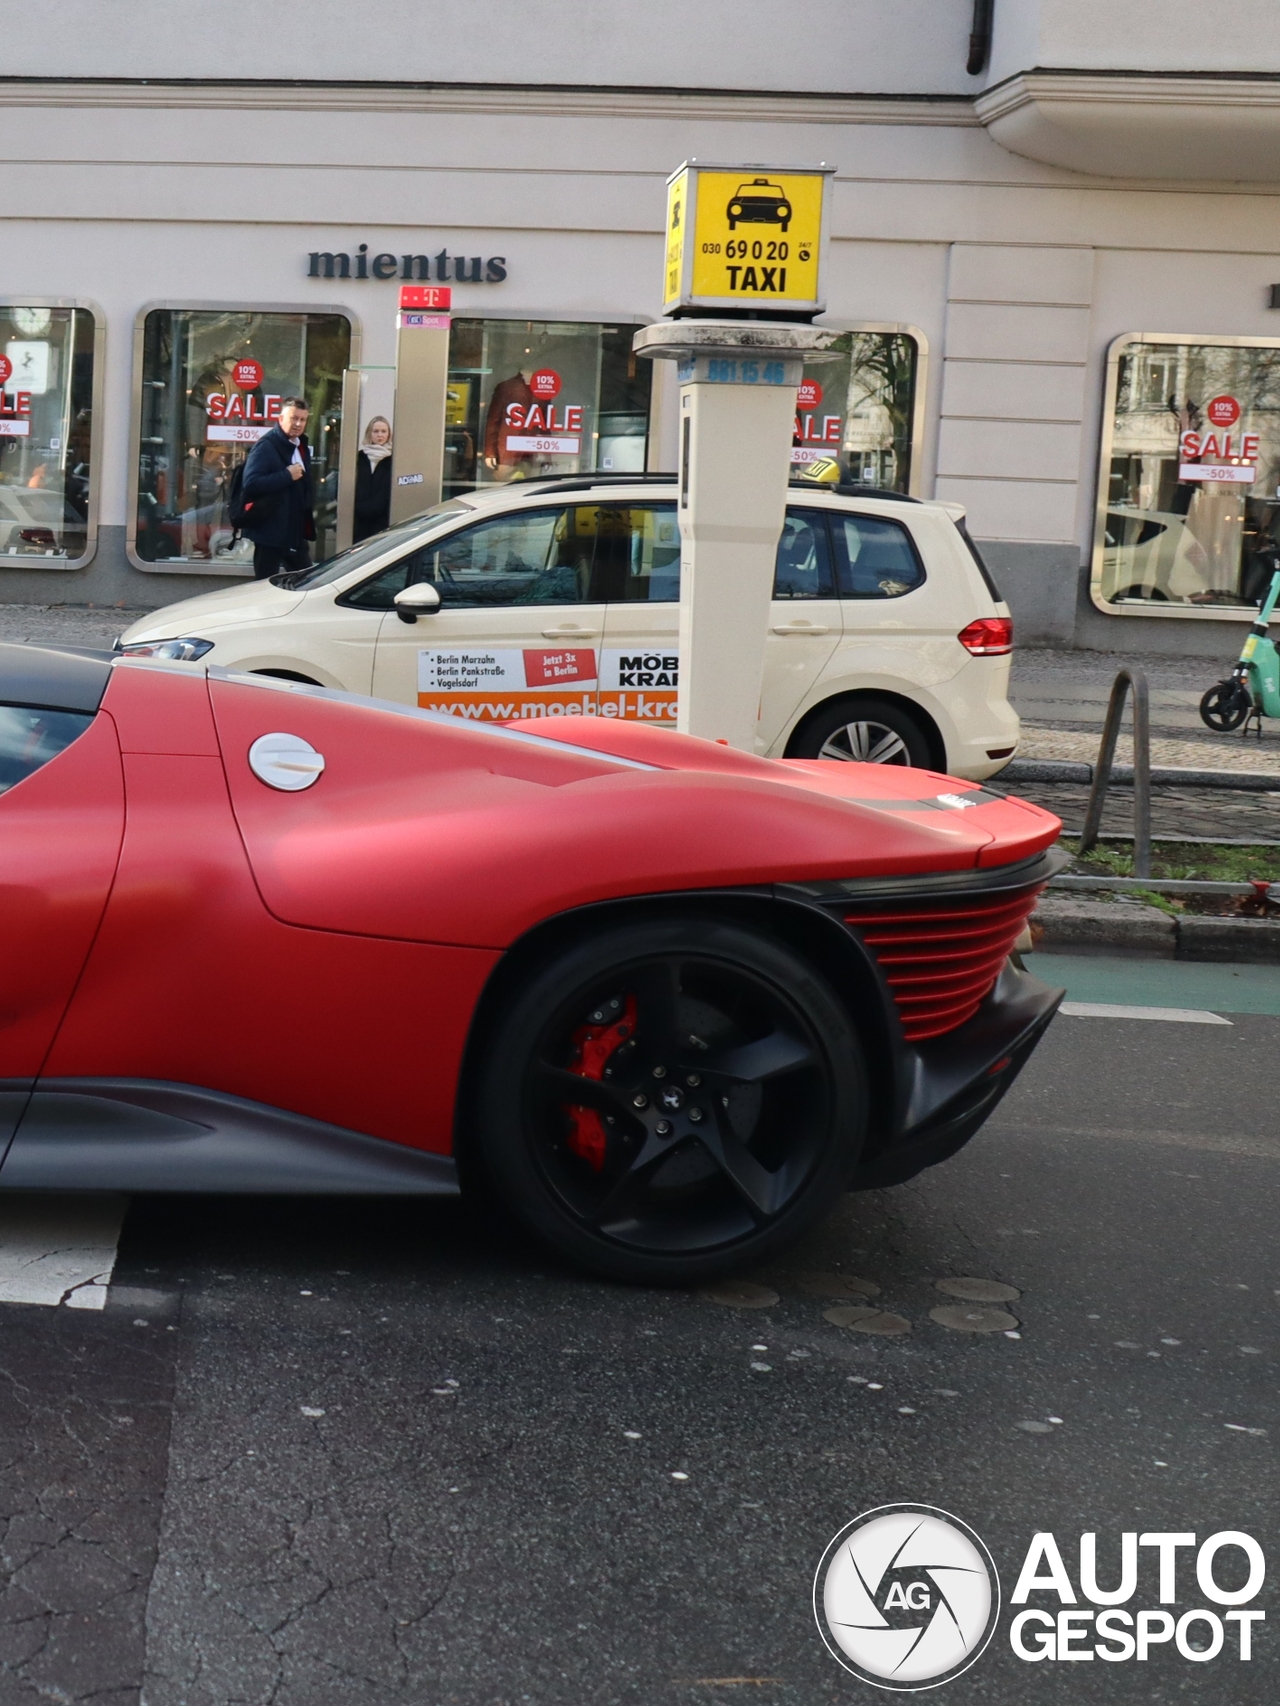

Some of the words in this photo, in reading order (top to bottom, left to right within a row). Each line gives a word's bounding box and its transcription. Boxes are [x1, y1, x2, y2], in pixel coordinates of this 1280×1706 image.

[702, 243, 721, 254] 030
[307, 243, 507, 283] mientus
[726, 266, 786, 292] TAXI
[238, 366, 256, 374] 10%
[536, 376, 554, 384] 10%
[798, 386, 816, 394] 10%
[206, 393, 282, 421] SALE
[1214, 403, 1234, 412] 10%
[505, 402, 584, 432] SALE
[233, 430, 260, 439] -50%
[532, 440, 560, 450] -50%
[1179, 430, 1260, 460] SALE
[1206, 468, 1235, 479] -50%
[437, 655, 459, 664] Berlin
[461, 654, 496, 664] Marzahn
[543, 654, 562, 666] Jetzt
[565, 653, 576, 663] 3x
[620, 653, 678, 670] MÖB
[437, 666, 459, 676] Berlin
[461, 666, 506, 676] Pankstraße
[544, 669, 553, 678] in
[554, 664, 578, 676] Berlin
[437, 678, 478, 690] Vogelsdorf
